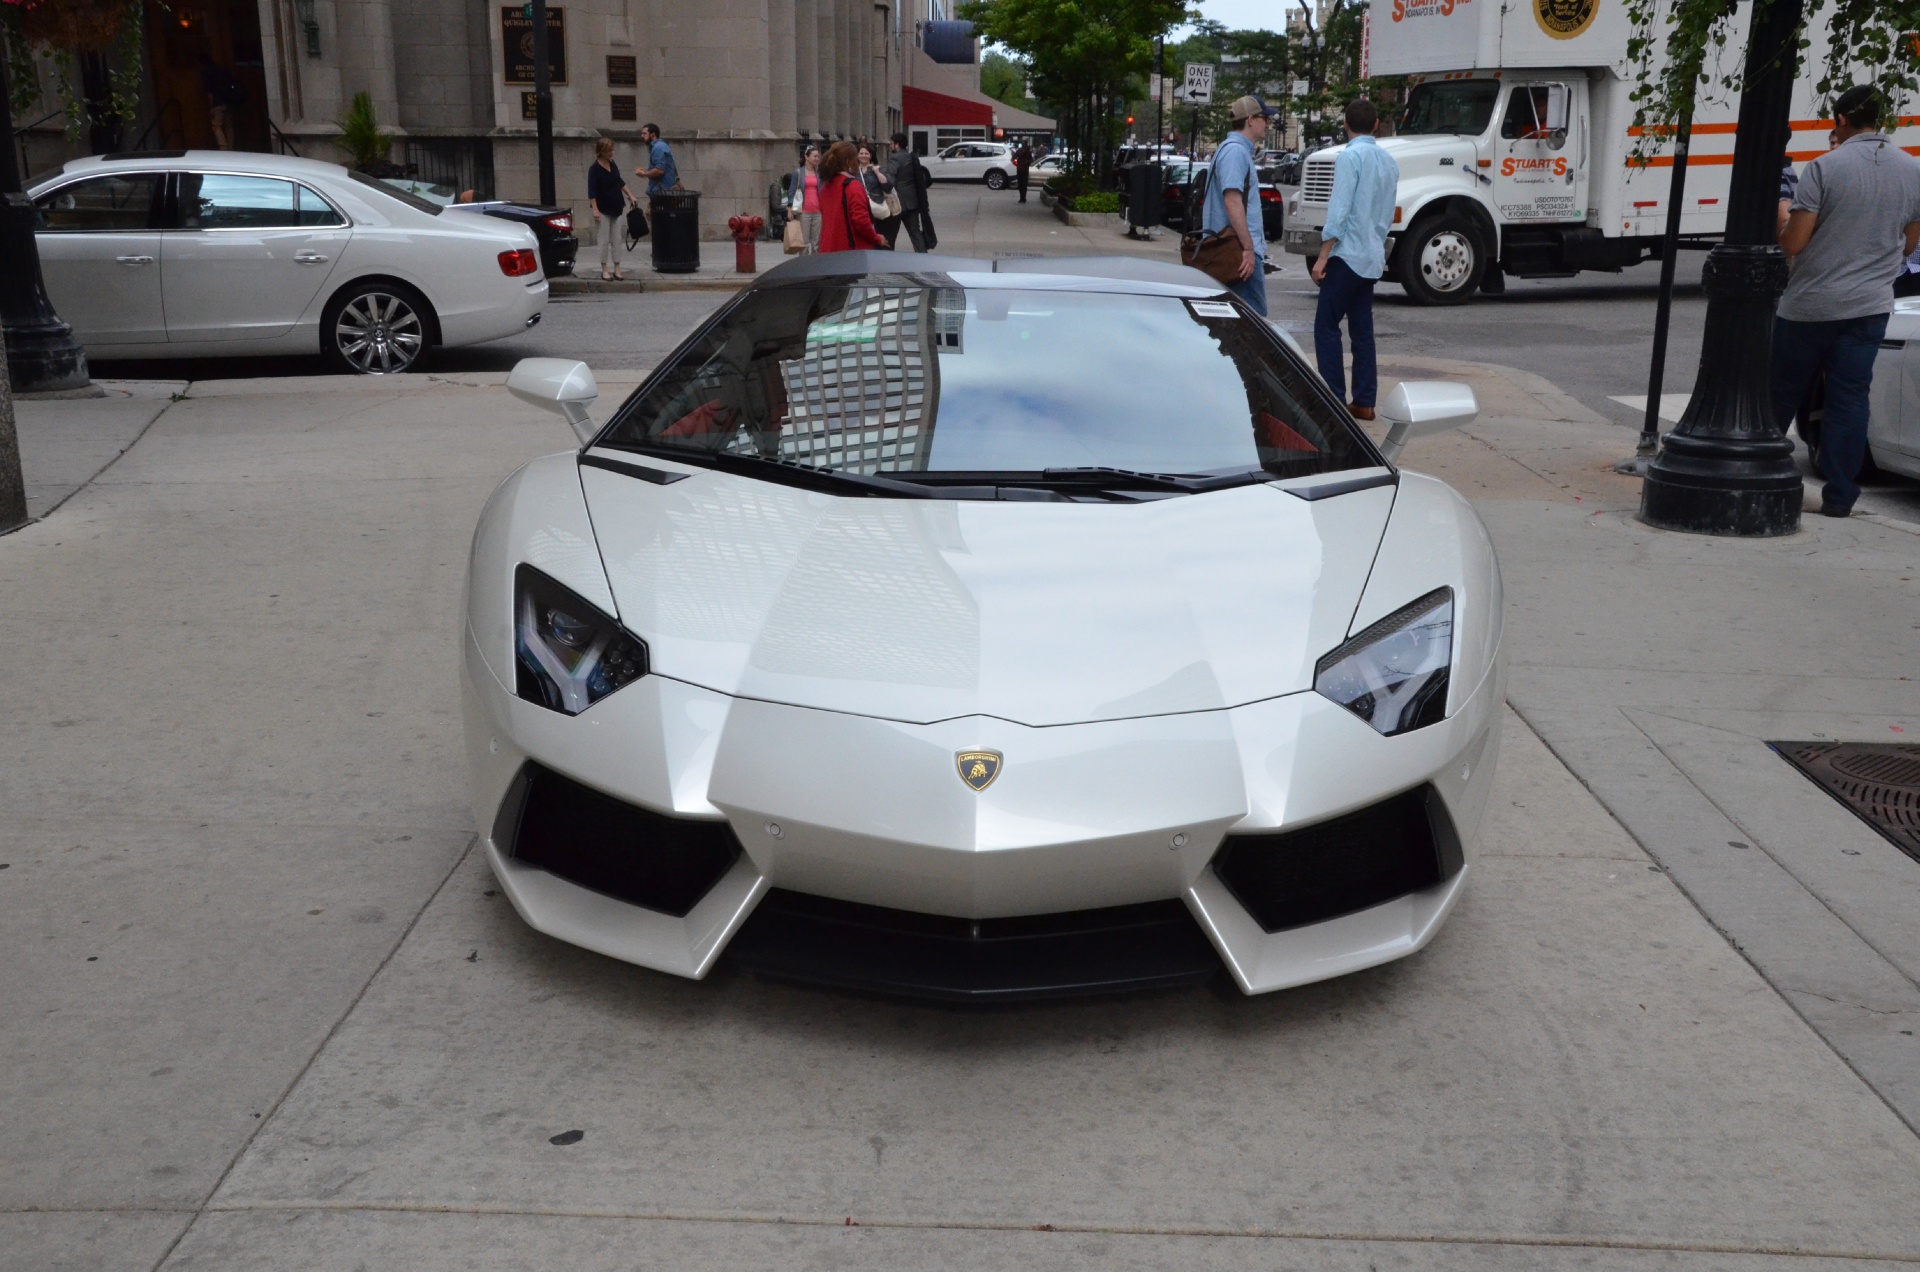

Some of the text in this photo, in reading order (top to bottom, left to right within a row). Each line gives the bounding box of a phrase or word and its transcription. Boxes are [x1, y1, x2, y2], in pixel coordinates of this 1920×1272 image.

[1189, 66, 1210, 77] ONE
[1188, 78, 1210, 88] WAY
[1500, 157, 1568, 176] STUART'S
